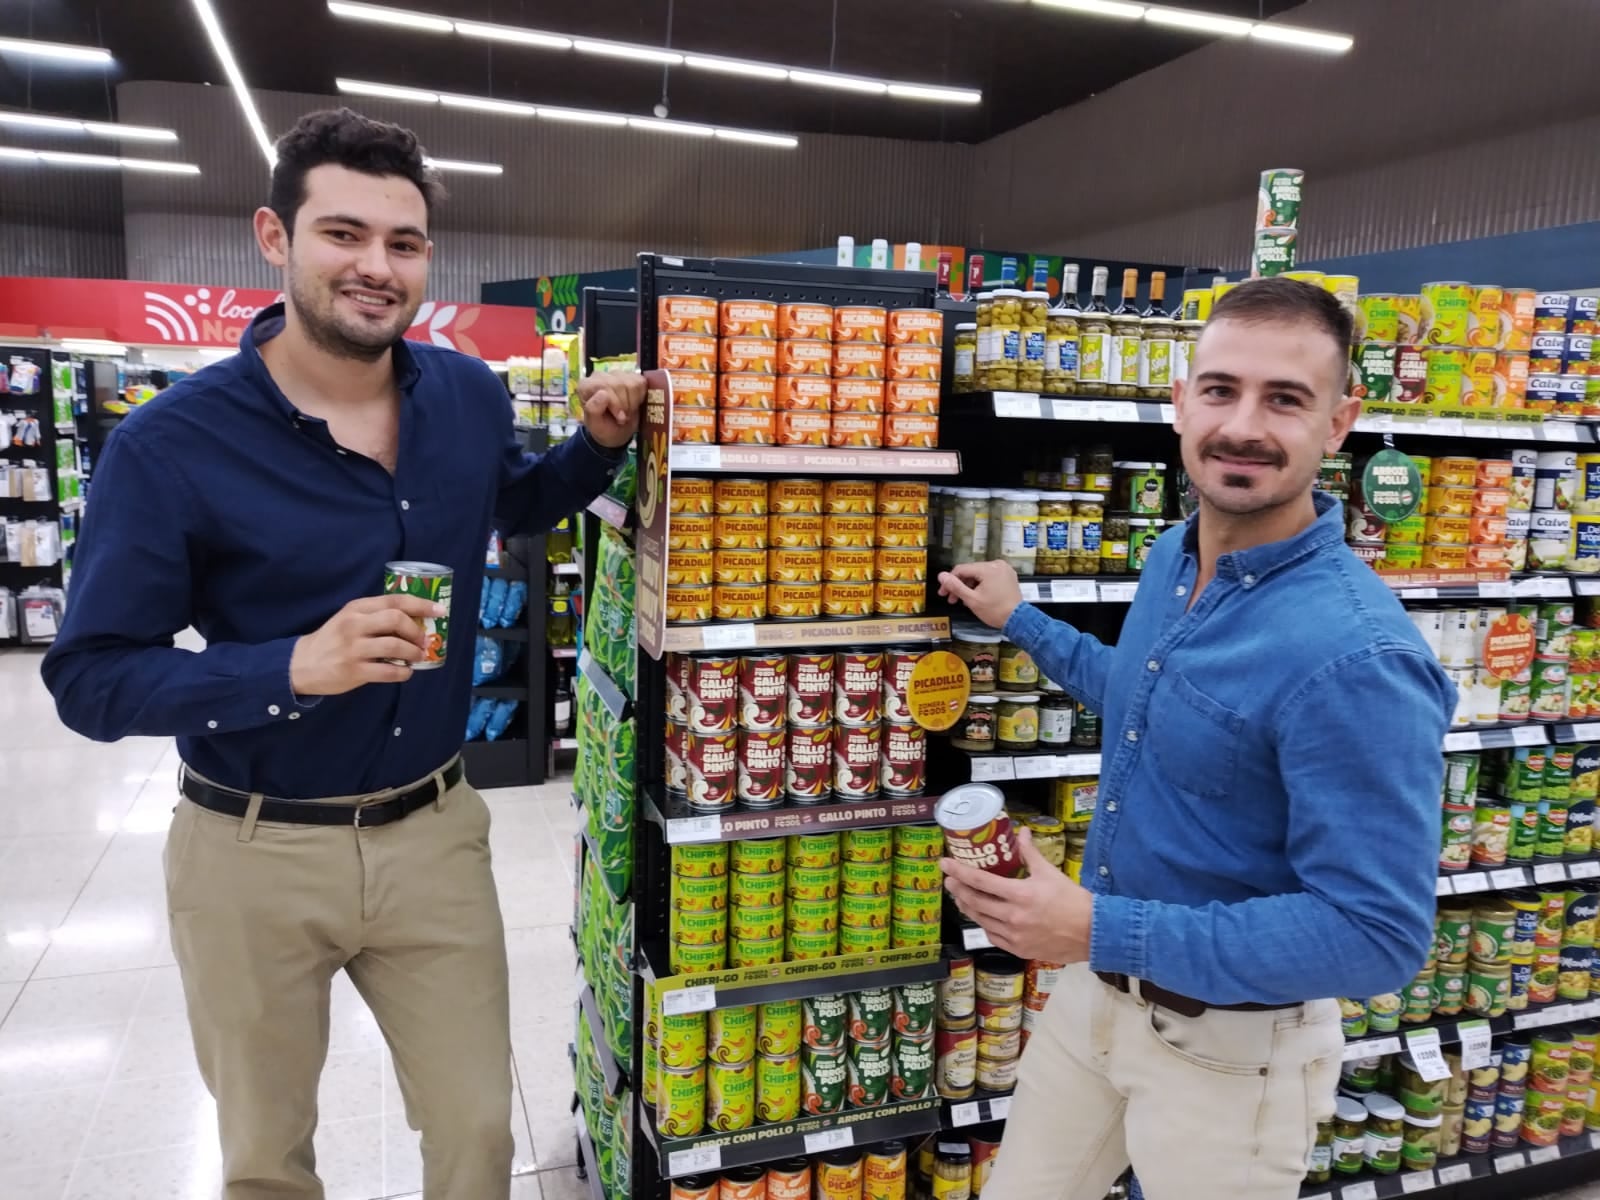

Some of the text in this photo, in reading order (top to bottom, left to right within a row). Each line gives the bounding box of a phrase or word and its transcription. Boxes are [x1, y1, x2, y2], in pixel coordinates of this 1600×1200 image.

[202, 319, 243, 342] Na
[898, 622, 948, 634] PICADILLO
[754, 675, 786, 685] GALLO
[798, 672, 830, 682] GALLO
[845, 671, 878, 681] GALLO
[699, 678, 734, 688] GALLO
[798, 682, 829, 692] PINTO
[845, 681, 878, 692] PINTO
[913, 674, 964, 690] PICADILLO
[700, 688, 733, 698] PINTO
[754, 685, 785, 696] PINTO
[792, 744, 825, 754] GALLO
[847, 743, 879, 753] GALLO
[889, 741, 921, 751] GALLO
[703, 751, 735, 762] GALLO
[747, 748, 781, 758] GALLO
[848, 752, 879, 762] PINTO
[889, 750, 921, 760] PINTO
[747, 758, 780, 768] PINTO
[792, 754, 825, 764] PINTO
[703, 761, 735, 773] PINTO
[818, 807, 887, 823] GALLO PINTO
[735, 819, 769, 832] PINTO
[880, 951, 929, 964] CHIFRI-GO
[784, 961, 836, 975] CHIFRI-GO
[685, 974, 739, 988] CHIFRI-GO
[836, 1102, 931, 1125] ARROZ CON POLLO
[732, 1132, 757, 1144] CON
[758, 1126, 793, 1140] POLLO
